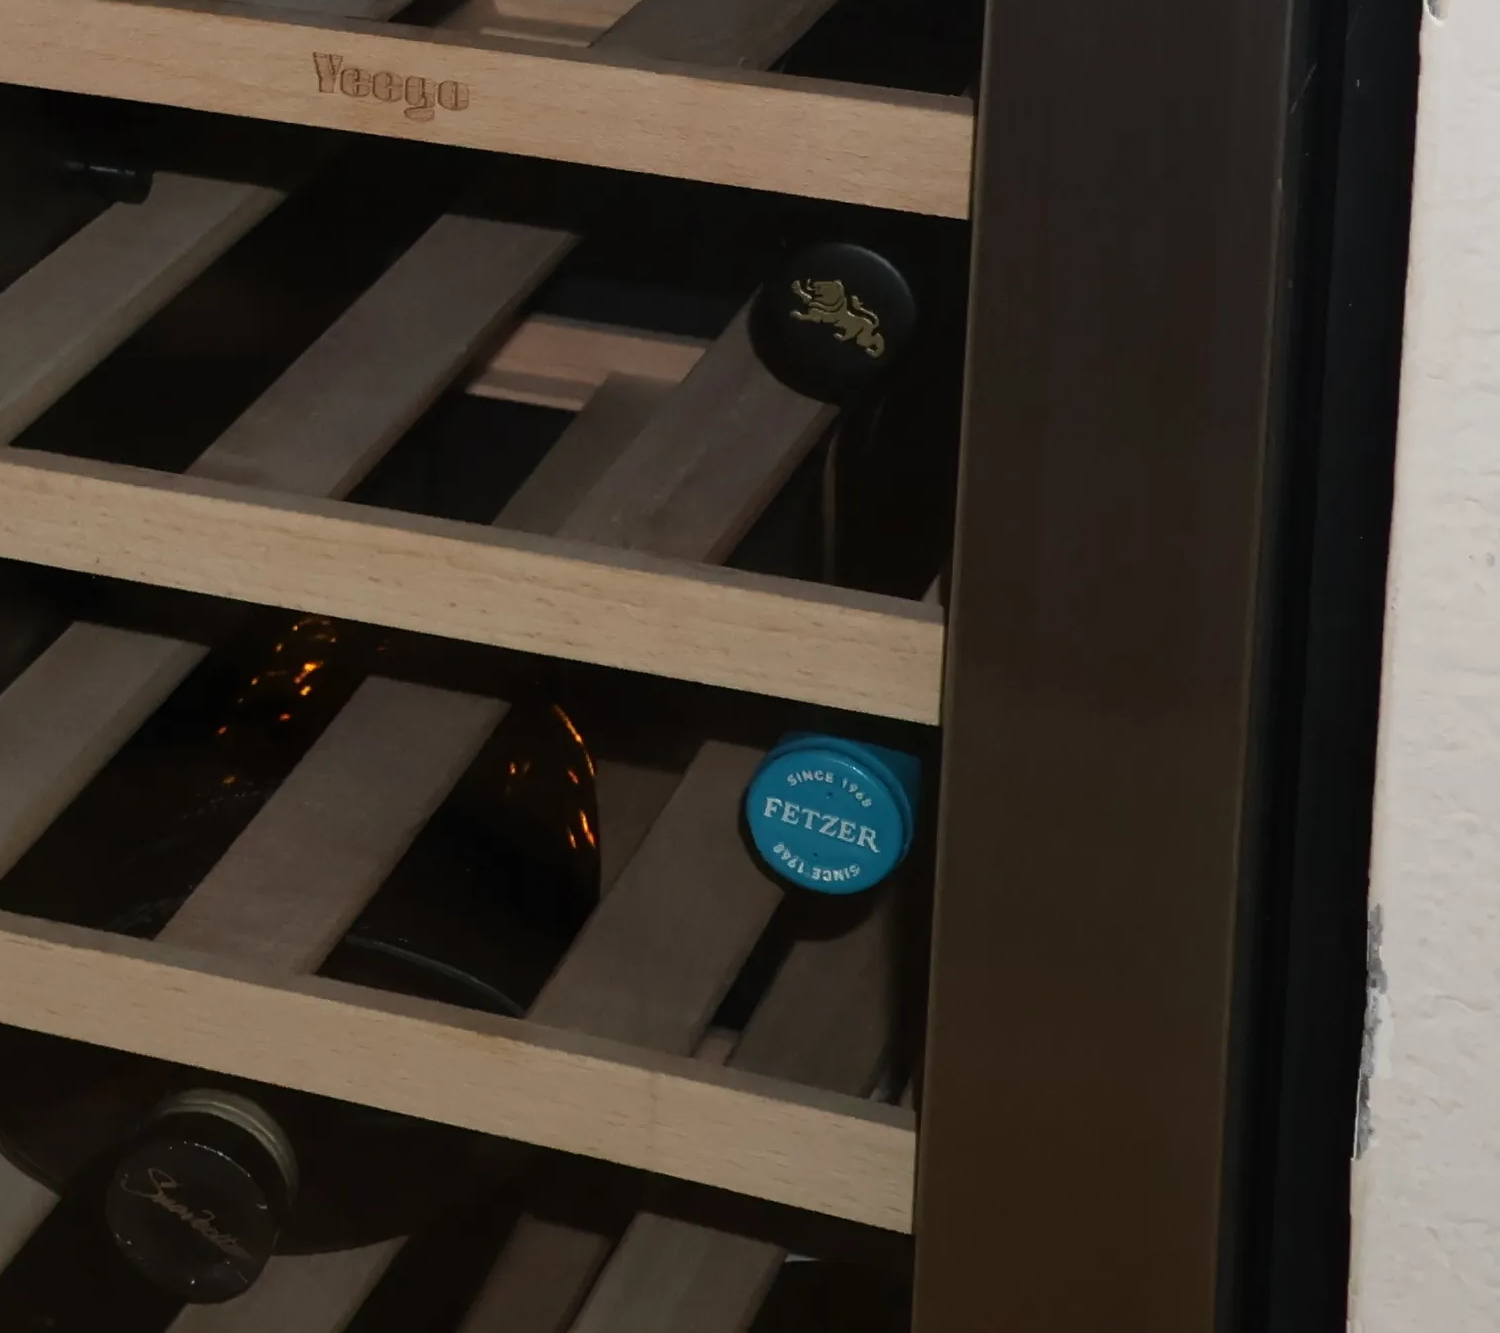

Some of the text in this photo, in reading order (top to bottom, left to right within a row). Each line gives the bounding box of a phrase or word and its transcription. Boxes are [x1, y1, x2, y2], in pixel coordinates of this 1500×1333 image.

[786, 769, 873, 808] SINCE 1968
[763, 796, 881, 854] FETZER
[811, 863, 861, 882] SINCE
